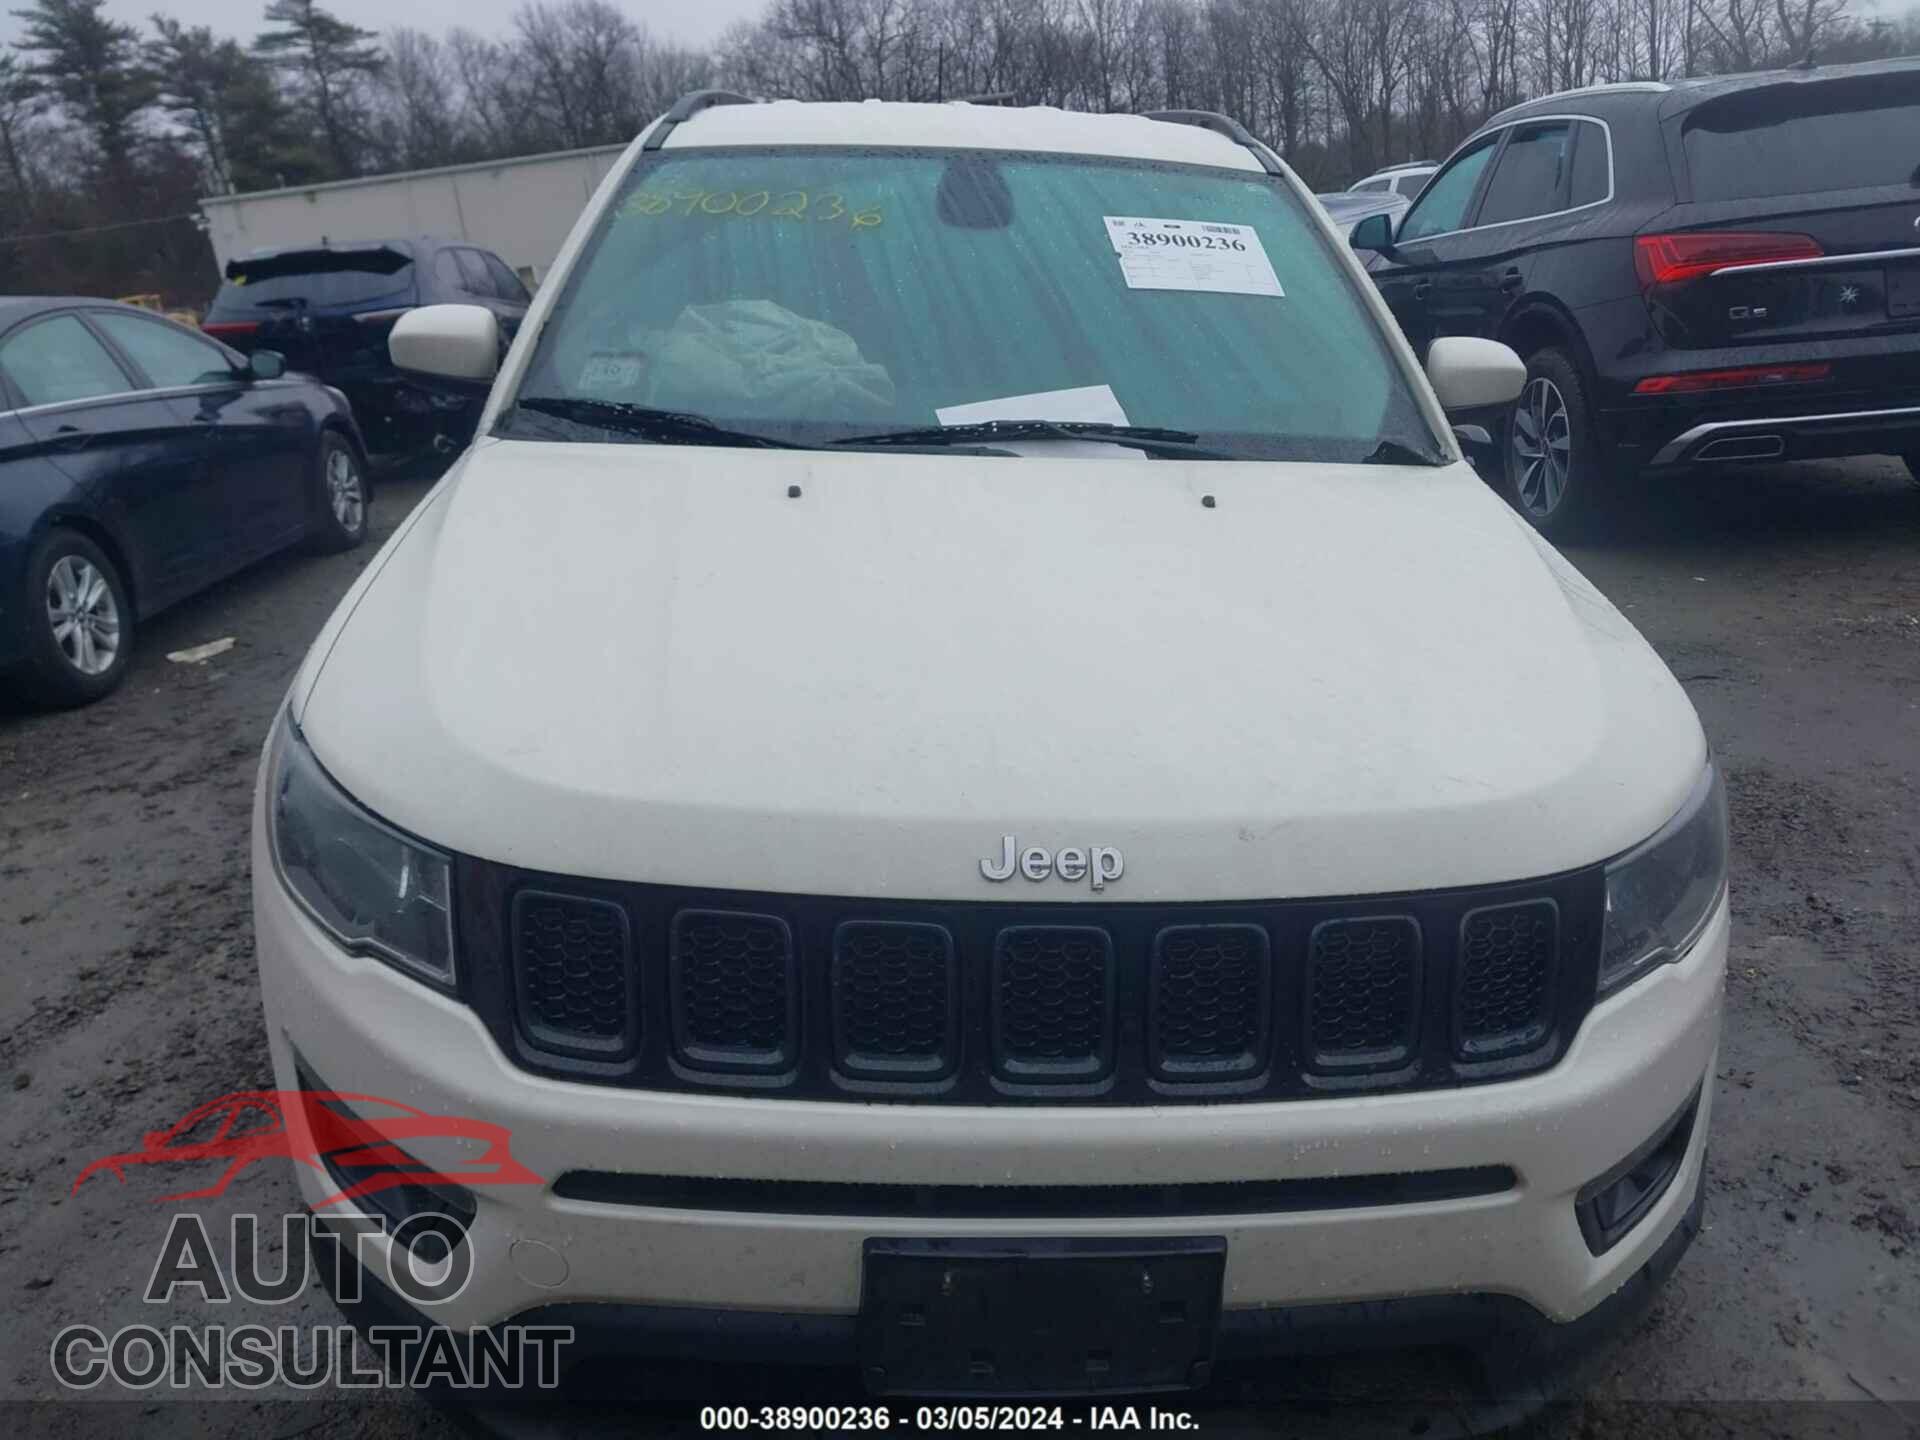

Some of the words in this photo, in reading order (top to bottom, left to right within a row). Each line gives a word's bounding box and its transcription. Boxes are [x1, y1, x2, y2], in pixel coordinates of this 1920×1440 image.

[1127, 231, 1247, 252] 38900236
[1728, 306, 1768, 320] Q5
[979, 835, 1125, 892] Jeep
